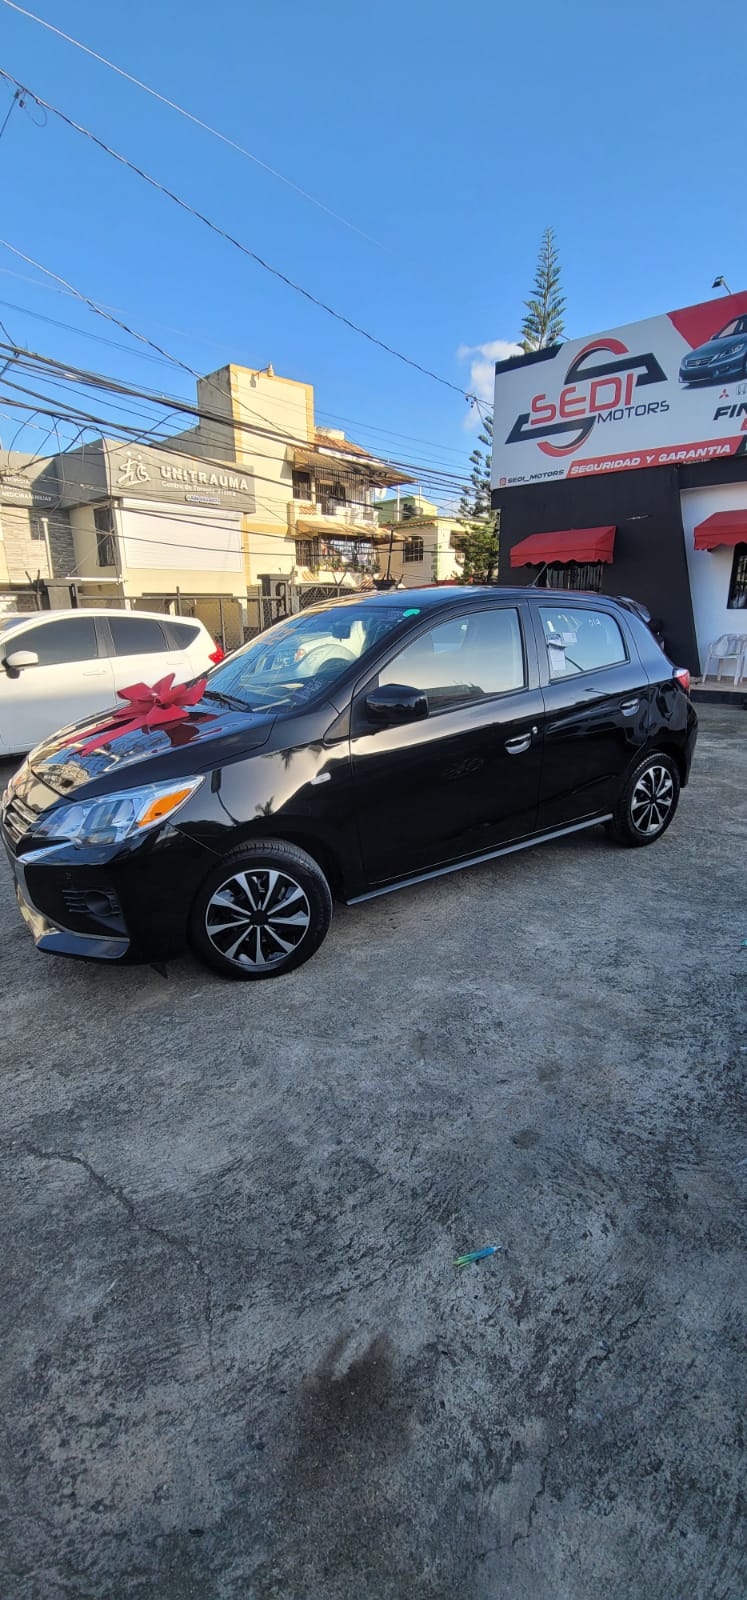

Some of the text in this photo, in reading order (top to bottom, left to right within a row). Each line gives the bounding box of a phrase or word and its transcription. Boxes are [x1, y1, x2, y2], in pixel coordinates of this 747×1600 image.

[530, 373, 634, 425] SEDI
[597, 400, 670, 424] MOTORS
[570, 444, 731, 475] SEGURIDAD Y GARANTIA
[160, 466, 249, 491] UNITRAUMA
[507, 469, 565, 483] SEDI_MOTORS
